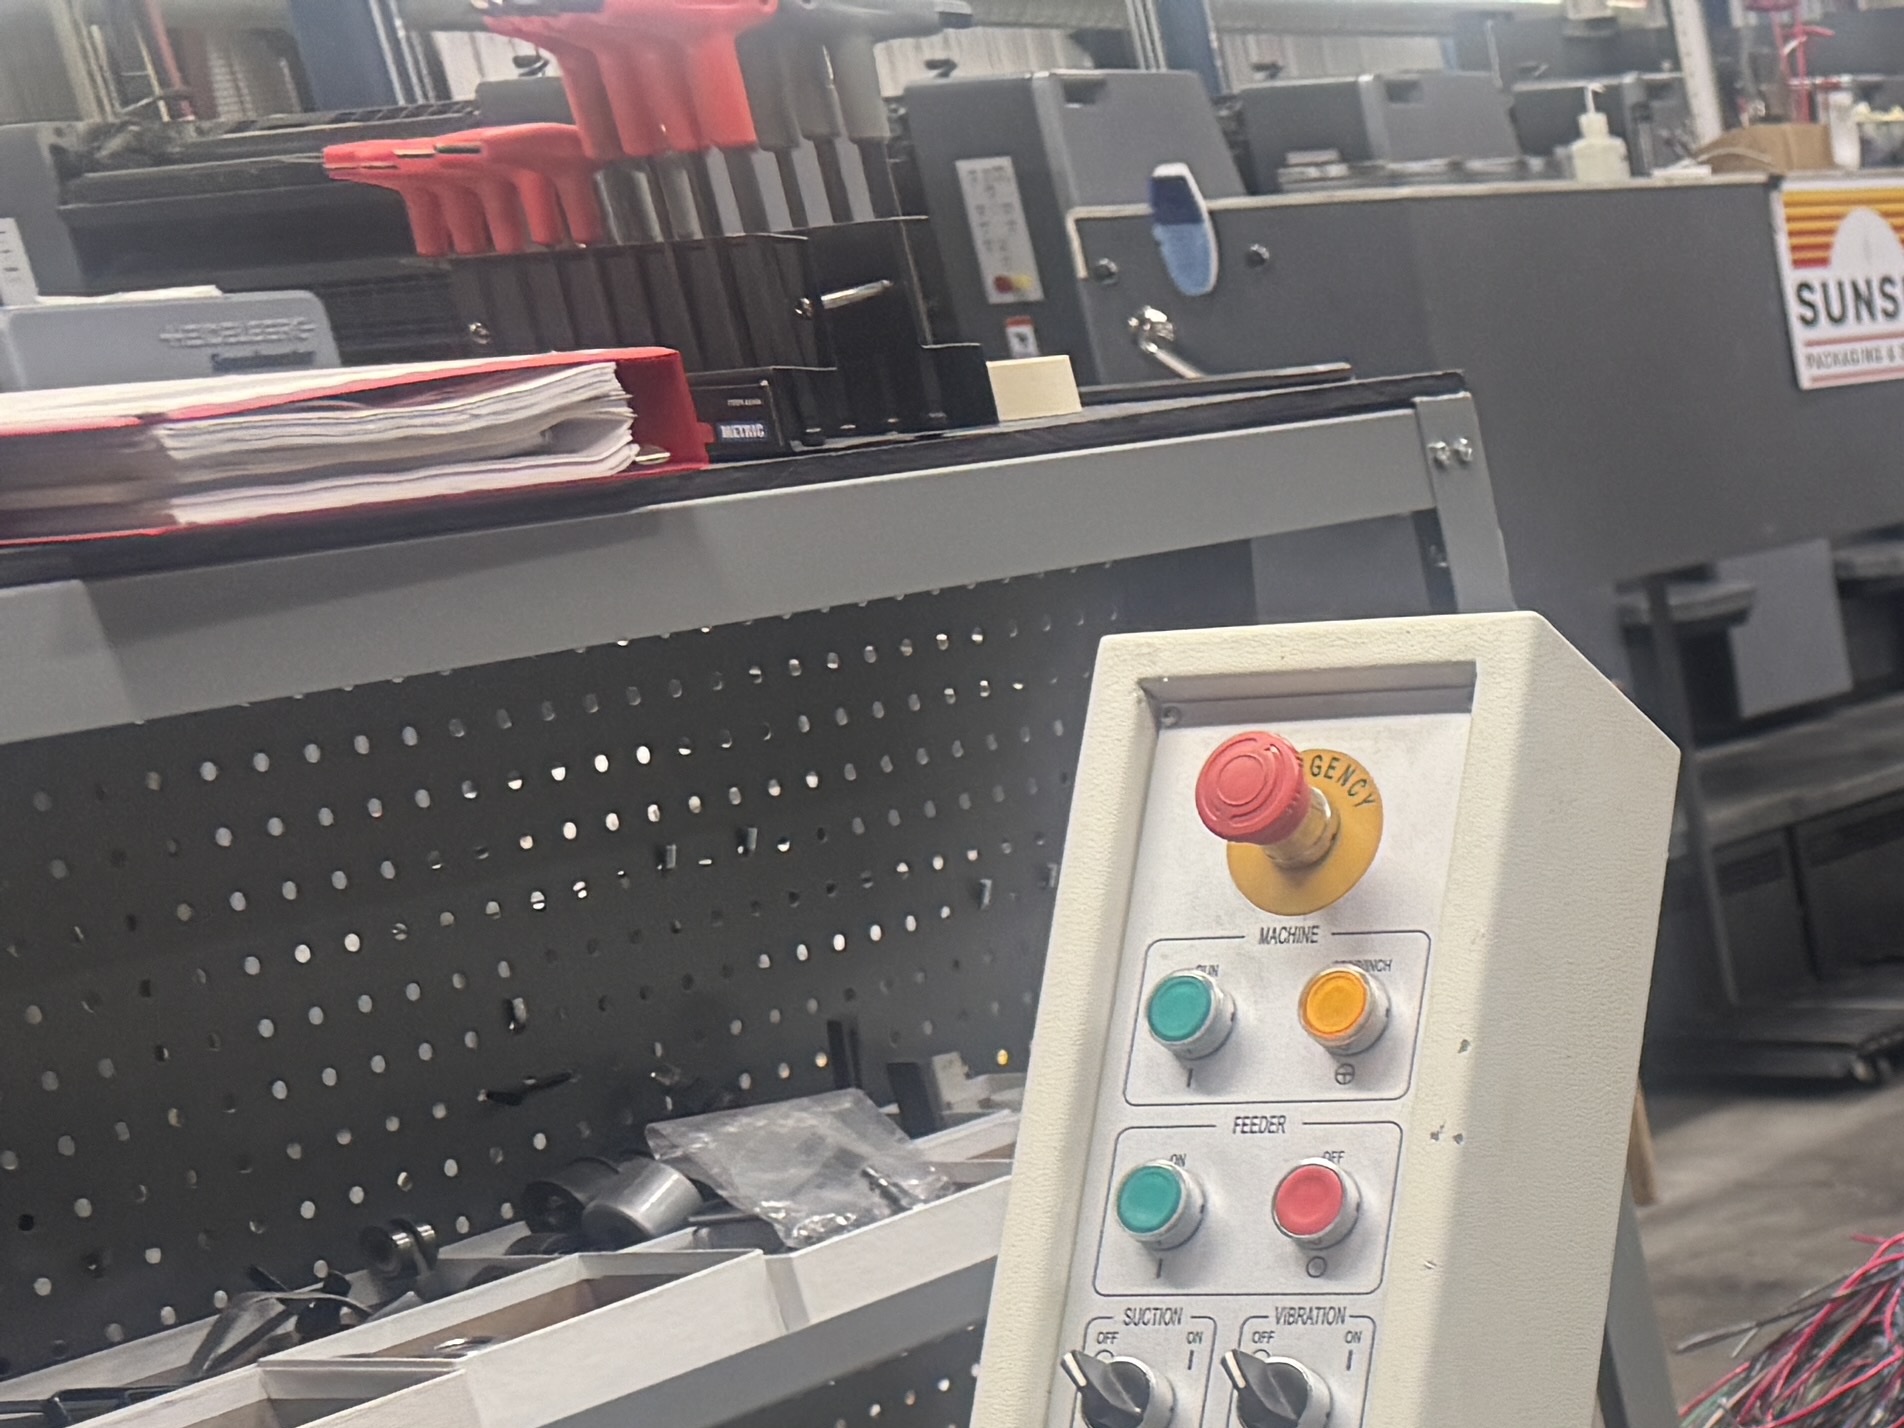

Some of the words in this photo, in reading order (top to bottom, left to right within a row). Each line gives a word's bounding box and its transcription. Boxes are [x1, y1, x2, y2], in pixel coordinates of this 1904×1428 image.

[720, 423, 765, 439] METRIC
[1258, 925, 1320, 945] MACHINE
[1232, 1115, 1287, 1134] FEEDER
[1170, 1154, 1187, 1168] ON
[1322, 1151, 1345, 1164] OFF
[1123, 1307, 1184, 1326] SUCTION
[1275, 1306, 1347, 1327] VIBRATION
[1096, 1331, 1119, 1345] OFF
[1186, 1331, 1203, 1345] ON
[1252, 1331, 1275, 1344] OFF
[1345, 1331, 1362, 1344] ON
